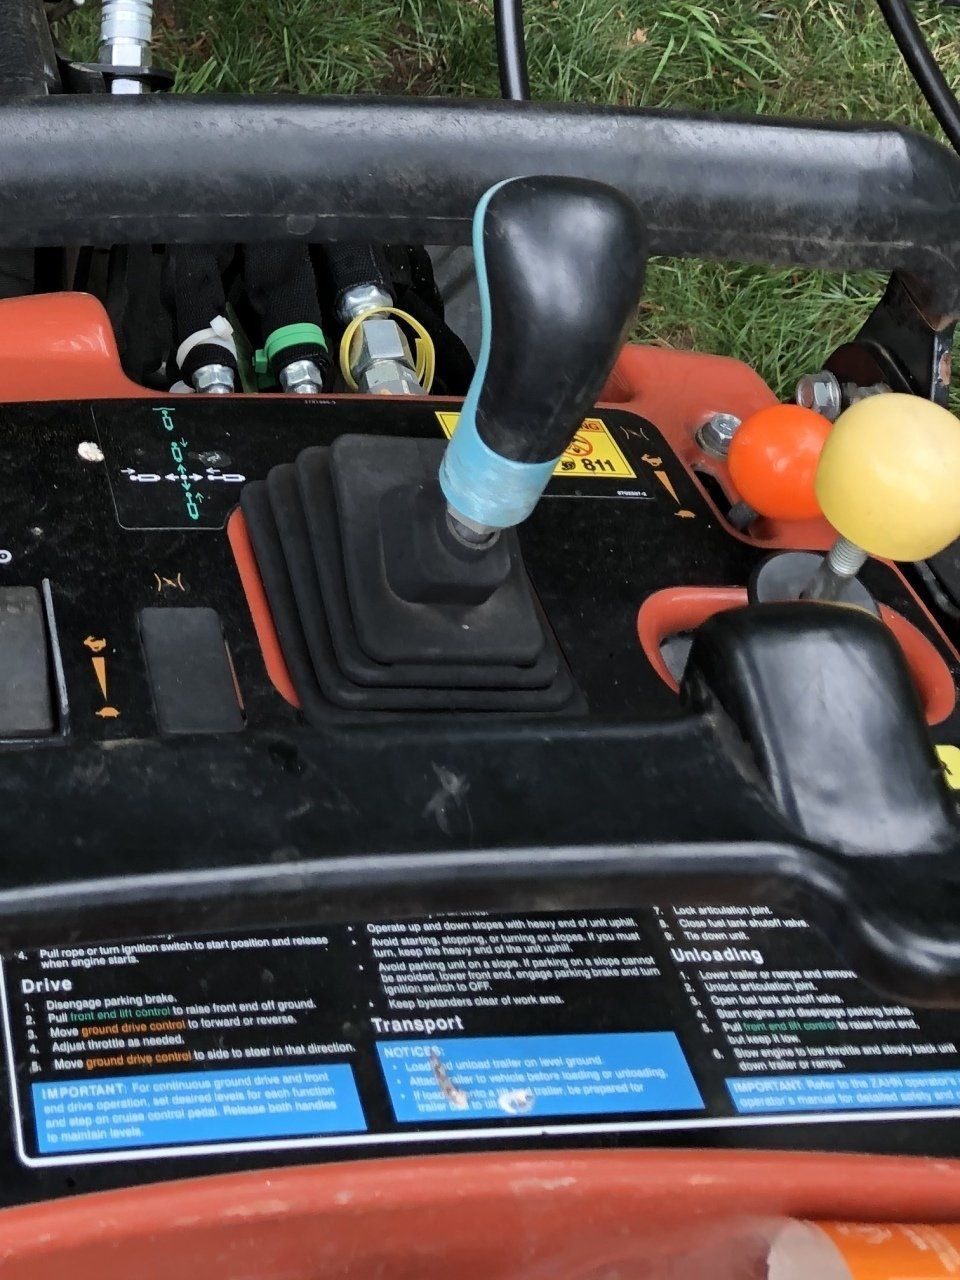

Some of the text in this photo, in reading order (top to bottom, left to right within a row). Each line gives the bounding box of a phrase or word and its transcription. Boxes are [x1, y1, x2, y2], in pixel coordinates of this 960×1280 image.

[581, 457, 616, 472] 811
[366, 917, 638, 934] Operate up and down slopes with heavy end of unit uphill.
[39, 948, 59, 958] Pull
[61, 948, 84, 958] rope
[86, 947, 97, 955] or
[98, 946, 120, 954] turn
[121, 943, 158, 957] ignition
[160, 941, 192, 951] switch
[192, 940, 204, 949] to
[205, 939, 229, 949] start
[230, 937, 270, 950] position
[271, 936, 290, 946] and
[291, 936, 328, 945] release
[371, 931, 640, 948] Avoid starting, stopping, or turning on slopes. If you must
[373, 942, 573, 957] turn, keep the heavy end of the unit uphill.
[670, 947, 764, 964] Unloading
[40, 953, 139, 968] when engine starts.
[378, 955, 655, 973] Avoid parking unit on a slope. If parking on a slope cannot
[380, 966, 660, 983] be avoided, lower front end, engage parking brake and turn
[21, 978, 73, 994] Drive
[383, 983, 421, 996] ignition
[422, 982, 455, 992] switch
[455, 982, 467, 991] to
[46, 998, 101, 1010] Disengage
[103, 995, 143, 1008] parking
[144, 993, 177, 1004] brake.
[388, 994, 564, 1010] Keep bystanders clear of work area.
[47, 1012, 67, 1023] Pull
[70, 1011, 94, 1021] front
[96, 1009, 116, 1019] end
[119, 1008, 132, 1017] lift
[134, 1006, 170, 1017] control
[172, 1005, 183, 1015] to
[185, 1004, 210, 1014] raise
[212, 1002, 237, 1012] front
[238, 1001, 258, 1011] end
[260, 1000, 275, 1010] off
[277, 998, 316, 1012] ground.
[49, 1026, 78, 1038] Move
[81, 1023, 119, 1037] ground
[121, 1022, 147, 1032] drive
[149, 1019, 186, 1031] control
[187, 1019, 198, 1028] to
[200, 1016, 240, 1028] forward
[242, 1017, 253, 1026] or
[256, 1014, 297, 1024] reverse.
[371, 1015, 464, 1034] Transport
[52, 1040, 86, 1053] Adjust
[87, 1037, 125, 1049] throttle
[127, 1038, 140, 1047] as
[142, 1033, 184, 1046] needed.
[53, 1058, 83, 1069] Move
[85, 1054, 124, 1070] ground
[126, 1054, 153, 1065] drive
[154, 1050, 191, 1062] control
[193, 1050, 205, 1060] to
[206, 1048, 229, 1059] side
[231, 1047, 242, 1058] to
[244, 1046, 270, 1057] steer
[272, 1045, 283, 1055] in
[284, 1044, 306, 1055] that
[307, 1041, 355, 1054] direction.
